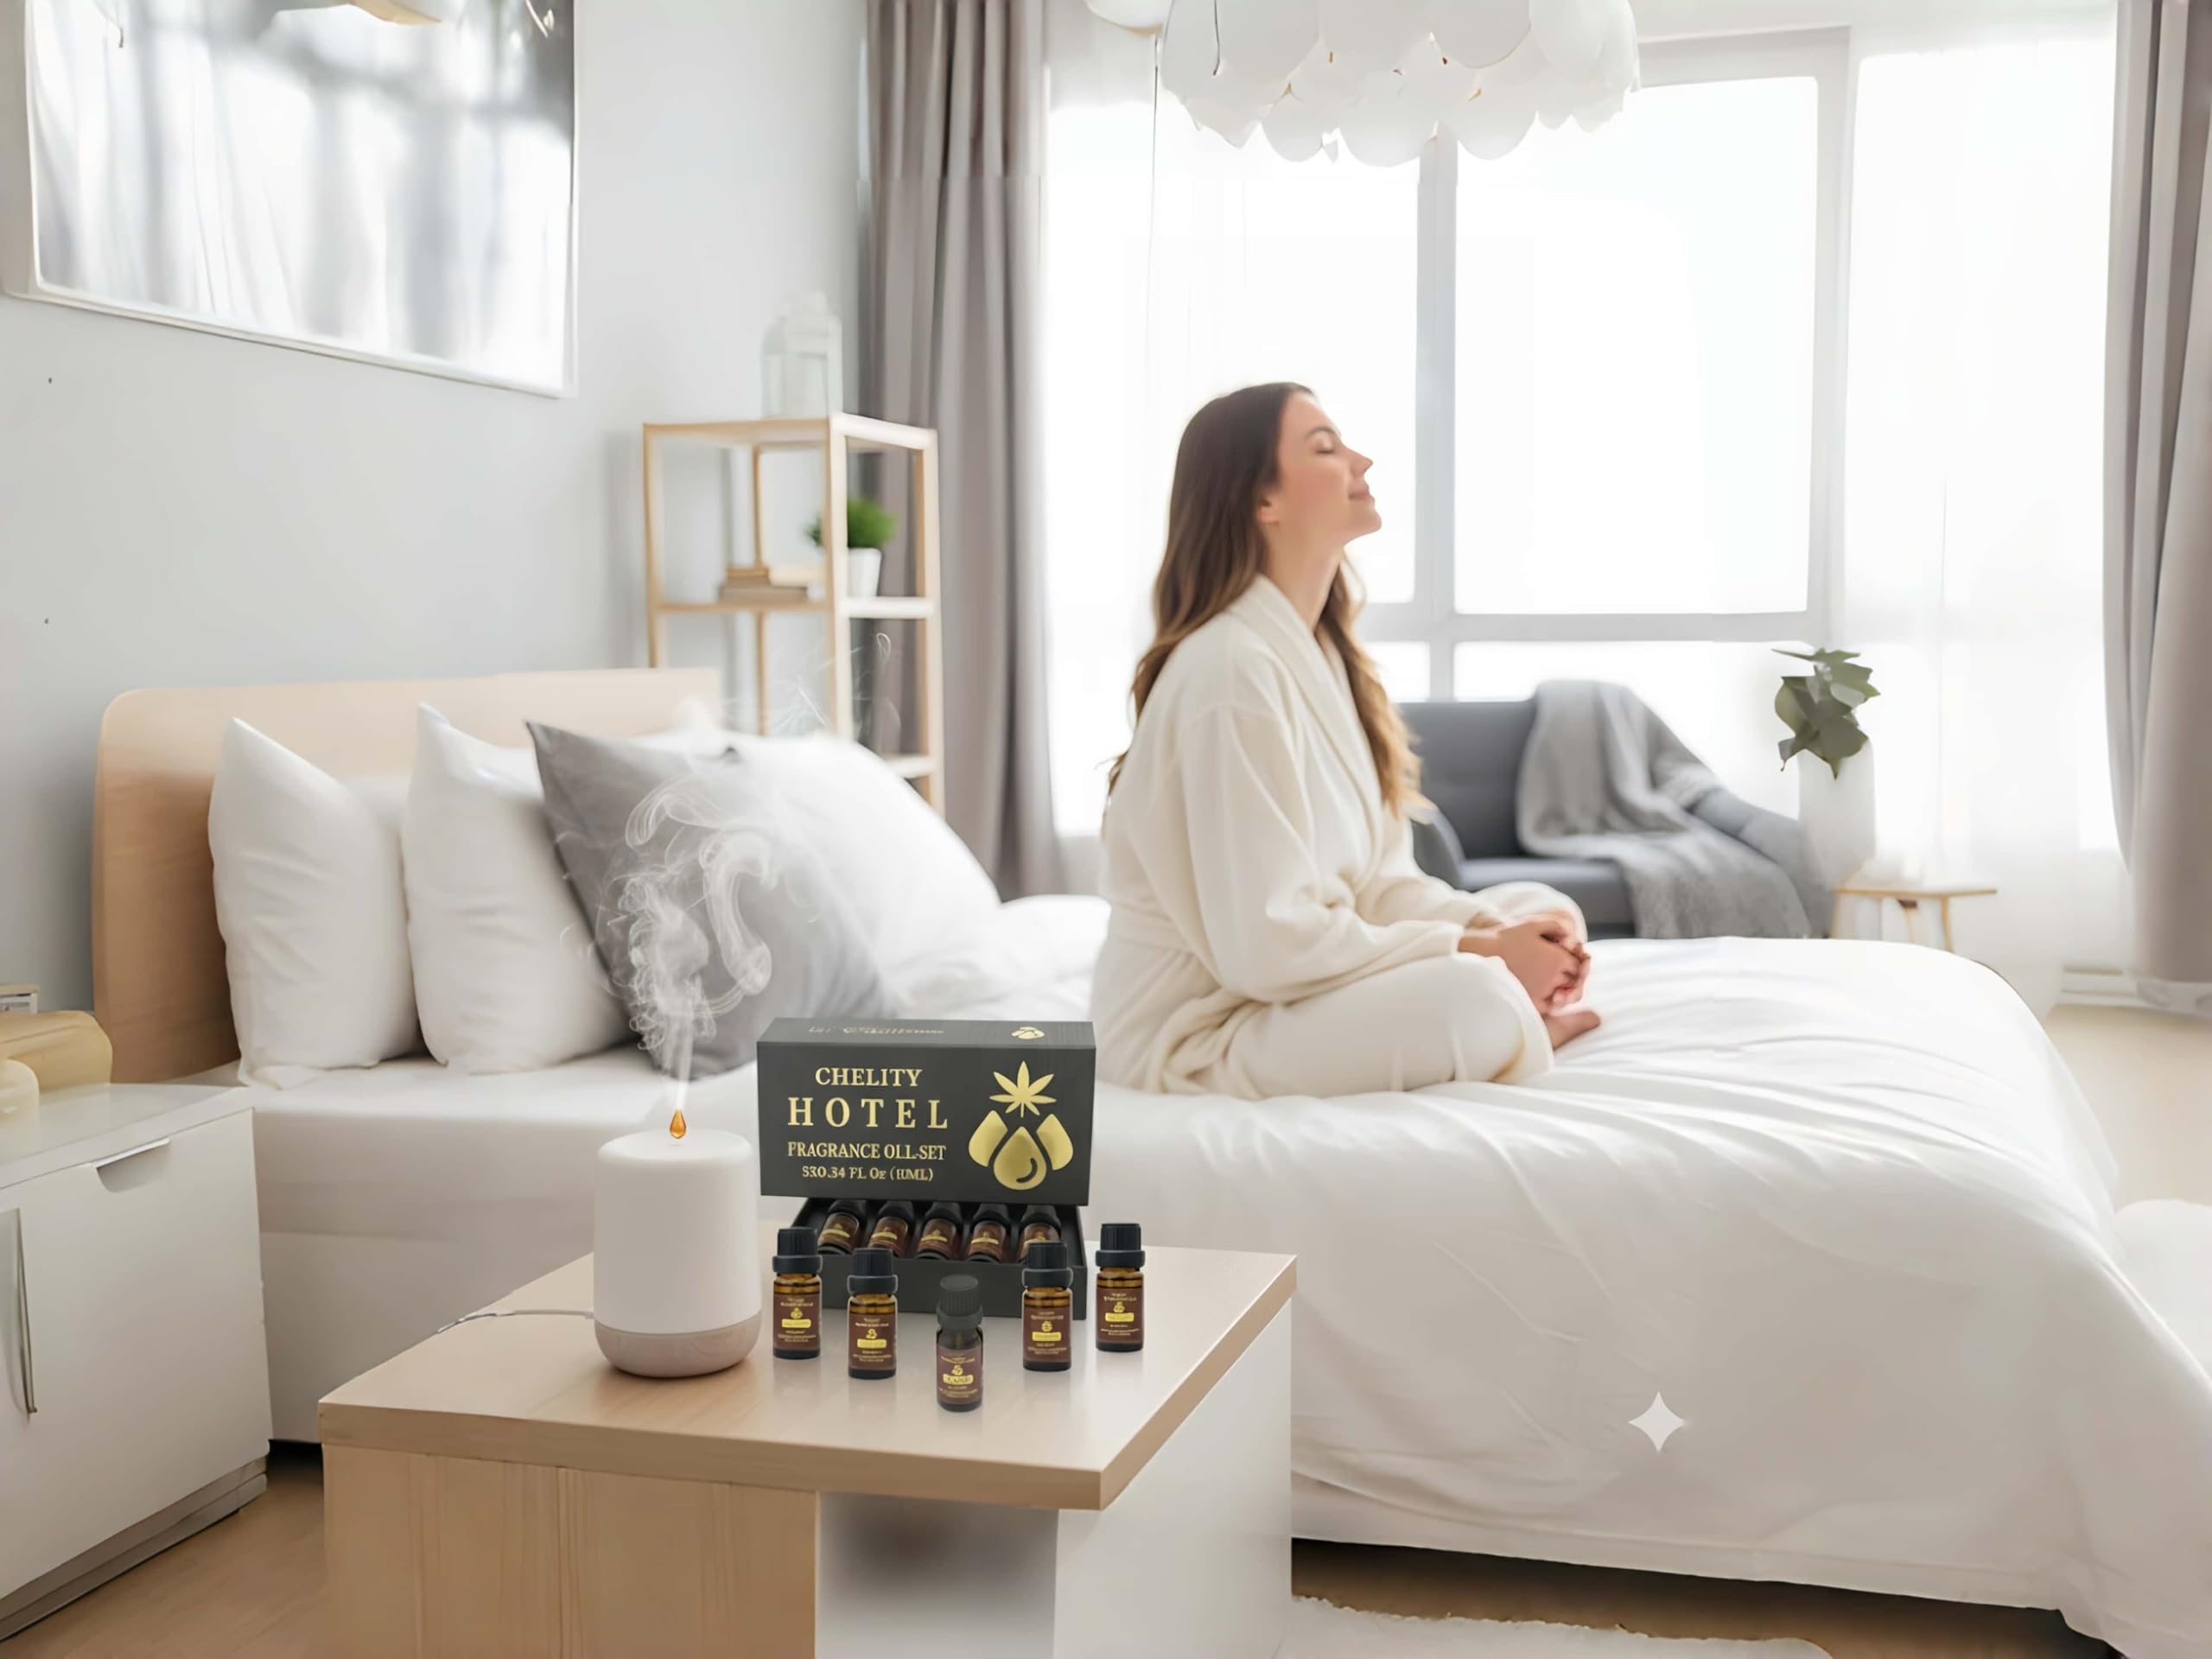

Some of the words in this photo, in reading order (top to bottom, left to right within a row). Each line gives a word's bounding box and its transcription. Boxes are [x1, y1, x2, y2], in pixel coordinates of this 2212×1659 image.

[815, 1067, 922, 1086] CHELITY
[787, 1096, 948, 1129] HOTEL
[787, 1141, 880, 1160] FRAGRANCE
